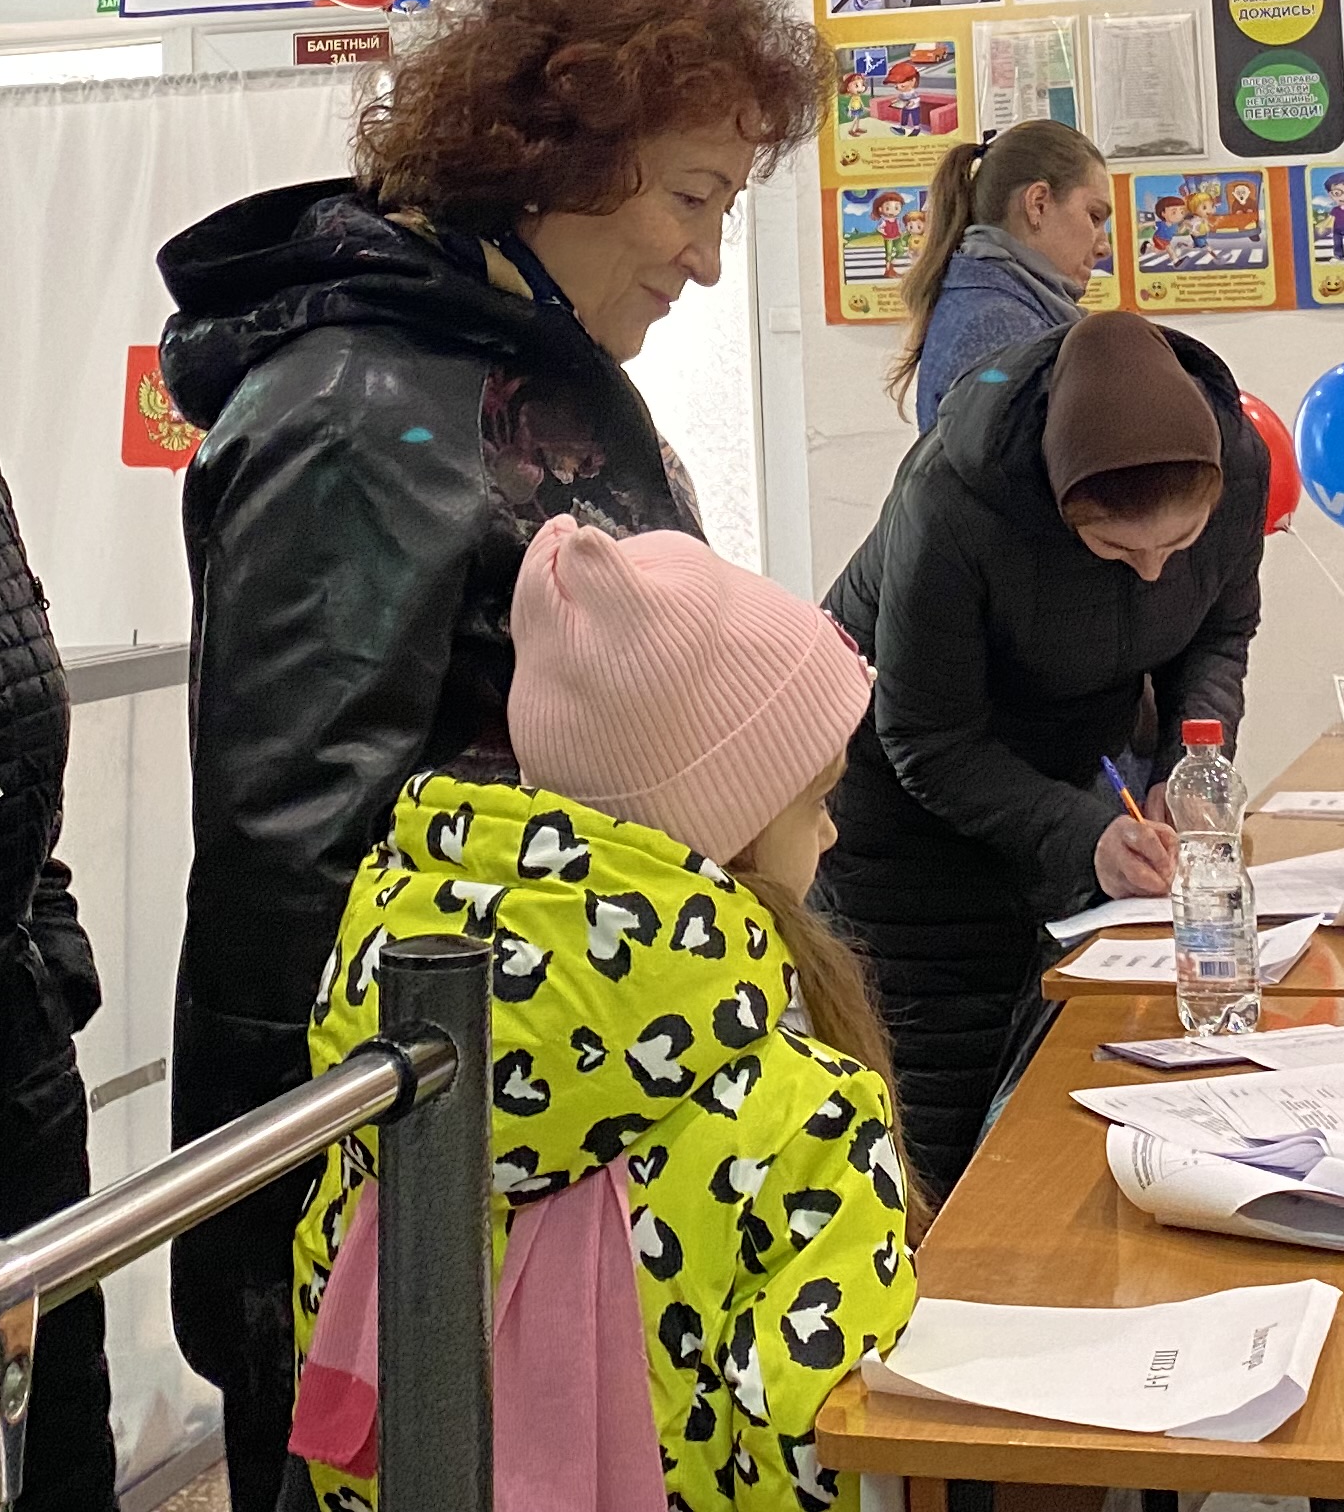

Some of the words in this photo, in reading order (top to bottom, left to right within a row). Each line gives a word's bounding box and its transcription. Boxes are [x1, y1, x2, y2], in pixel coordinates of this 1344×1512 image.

[1238, 3, 1316, 22] ДОЖДИСЬ!
[307, 35, 380, 52] БАЛЕТНЫЙ
[1279, 73, 1320, 85] ВПРАВО
[1246, 97, 1265, 106] НЕТ
[1244, 105, 1323, 120] ПЕРЕХОДИ!
